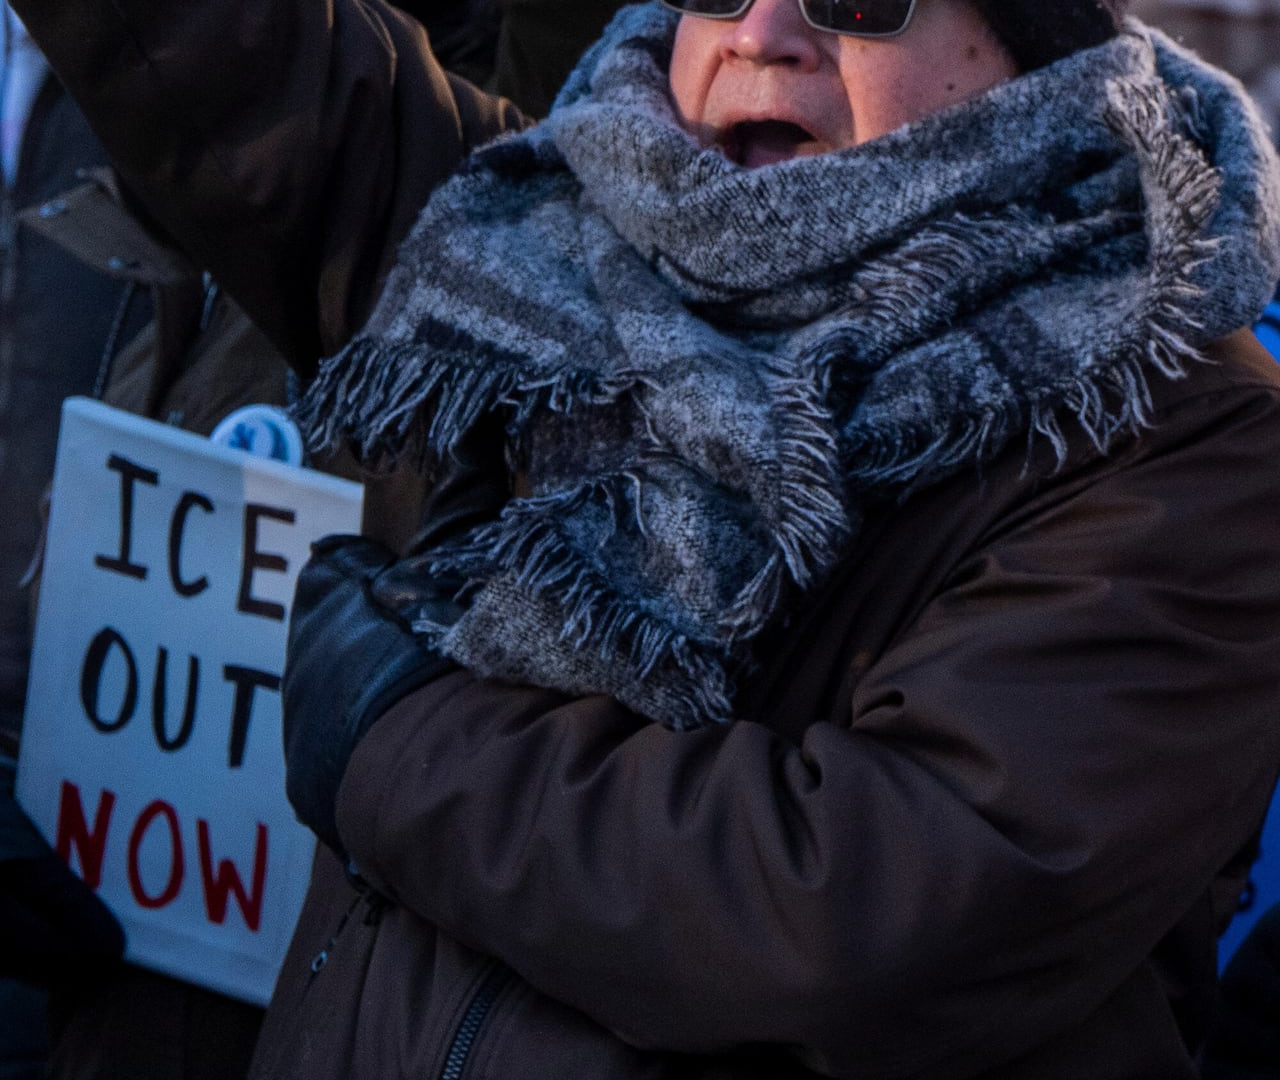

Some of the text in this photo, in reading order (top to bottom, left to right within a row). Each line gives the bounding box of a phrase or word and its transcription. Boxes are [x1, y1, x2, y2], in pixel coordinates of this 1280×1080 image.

[95, 453, 299, 621] ICE
[78, 626, 282, 770] OUT
[57, 779, 269, 933] NOW
